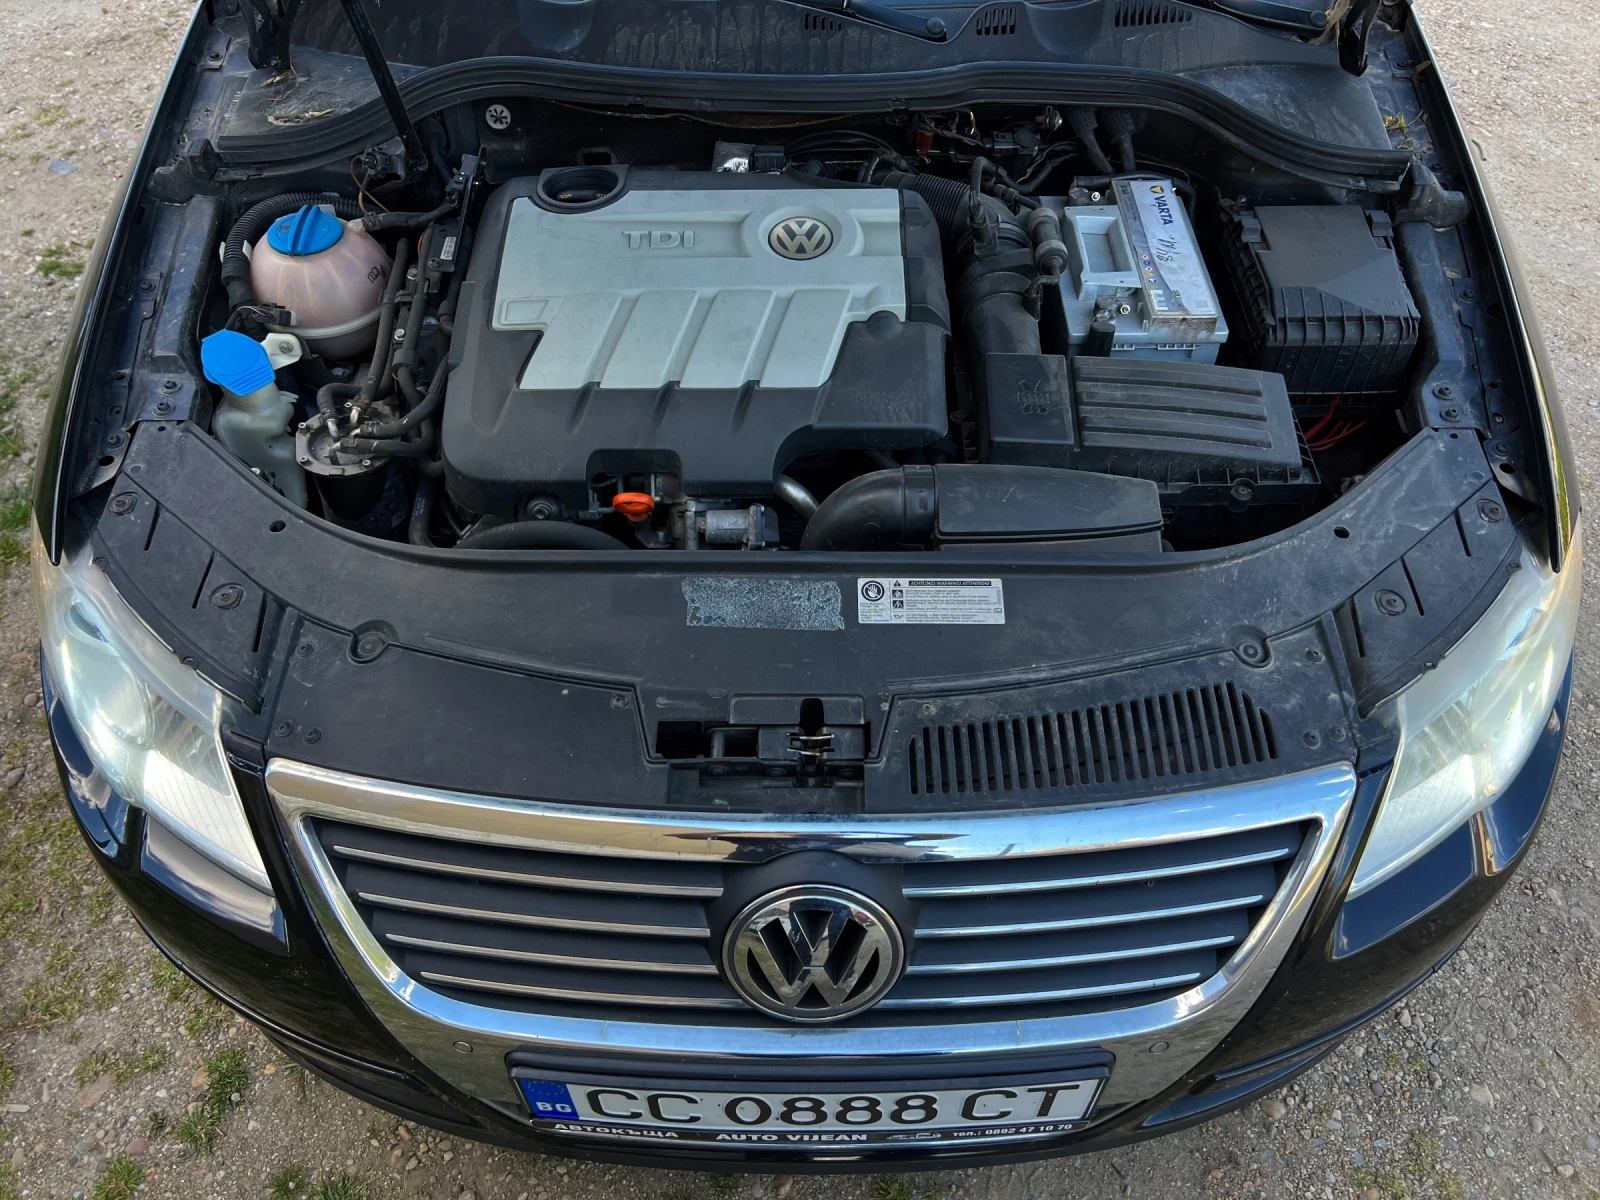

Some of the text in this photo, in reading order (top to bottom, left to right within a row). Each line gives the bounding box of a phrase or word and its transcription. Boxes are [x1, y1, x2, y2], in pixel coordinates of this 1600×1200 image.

[1154, 195, 1174, 225] VARTA
[622, 229, 695, 249] TDI
[535, 1101, 573, 1113] BG
[586, 1084, 1080, 1125] CC 0888 CT
[716, 1133, 778, 1141] AUTO
